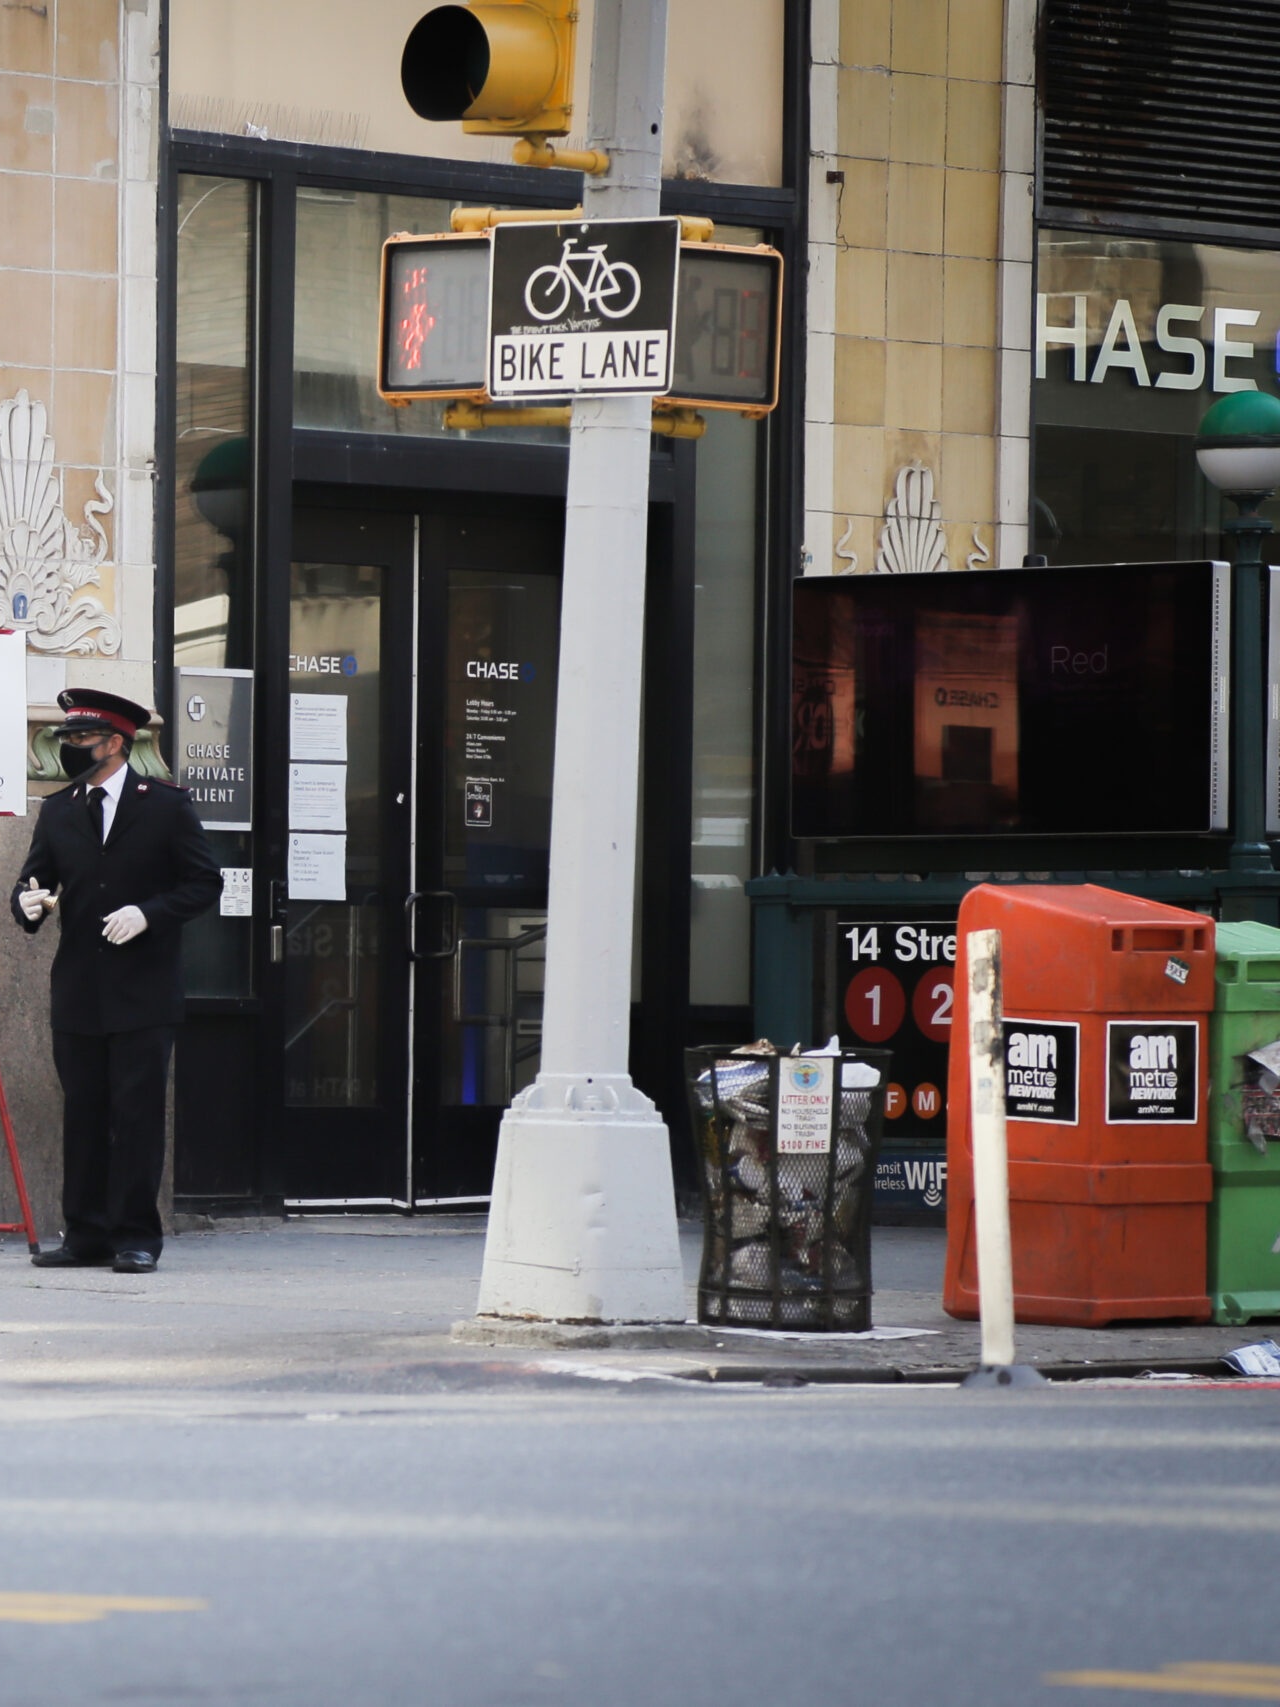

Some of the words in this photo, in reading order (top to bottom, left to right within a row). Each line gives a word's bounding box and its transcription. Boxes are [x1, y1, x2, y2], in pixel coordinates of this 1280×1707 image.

[500, 342, 565, 382] BIKE
[580, 339, 661, 379] LANE
[288, 654, 341, 674] CHASE
[1050, 644, 1108, 676] Red
[466, 660, 519, 681] CHASE
[187, 743, 230, 759] CHASE
[187, 766, 245, 782] PRIVATE
[467, 791, 490, 802] Smoking
[474, 784, 483, 793] No
[845, 926, 881, 961] 14
[864, 985, 881, 1026] 1
[931, 983, 954, 1025] 2
[1007, 1032, 1057, 1069] am
[1129, 1035, 1178, 1070] am
[1007, 1068, 1057, 1087] metro
[1129, 1069, 1178, 1087] metro
[781, 1094, 808, 1105] LITTER
[810, 1095, 831, 1105] ONLY
[886, 1091, 899, 1112] F
[918, 1090, 935, 1112] M
[1016, 1102, 1055, 1113] amNY.com
[781, 1107, 790, 1115] NO
[792, 1107, 829, 1115] HOUSEHOLD
[1137, 1105, 1175, 1114] amNY.com
[793, 1123, 828, 1131] BUSINESS
[780, 1140, 802, 1150] $100
[806, 1140, 826, 1150] FINE
